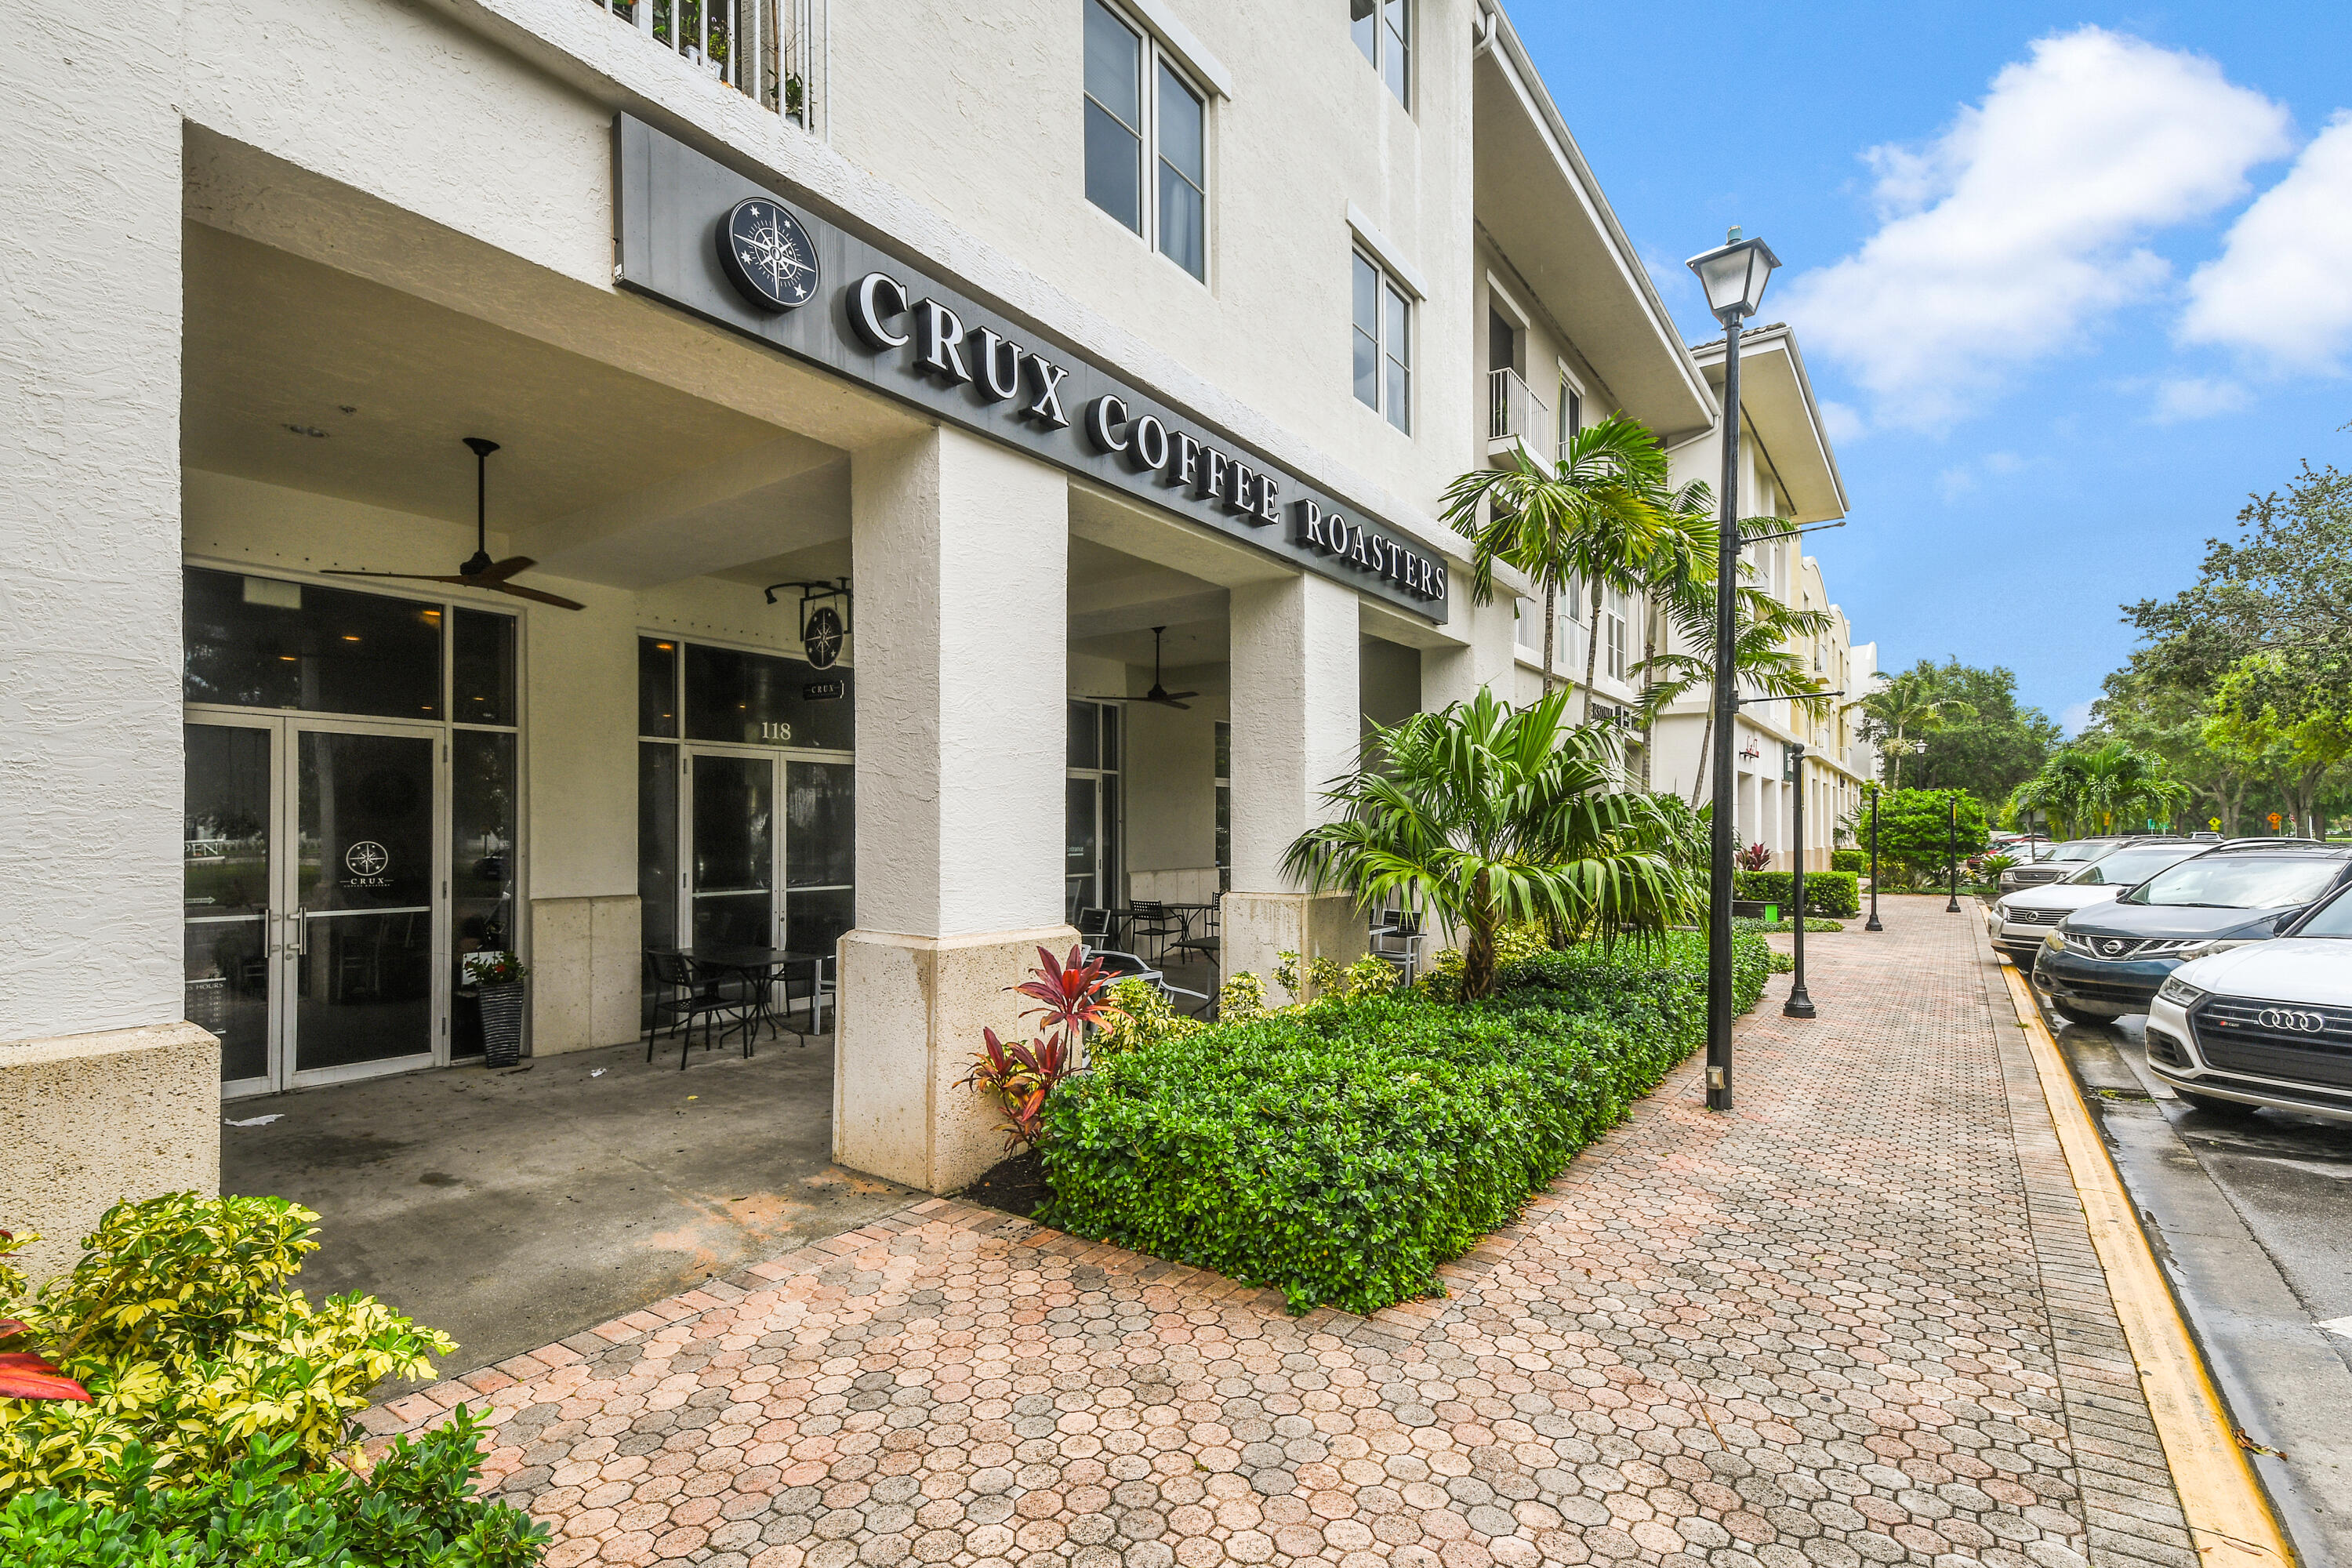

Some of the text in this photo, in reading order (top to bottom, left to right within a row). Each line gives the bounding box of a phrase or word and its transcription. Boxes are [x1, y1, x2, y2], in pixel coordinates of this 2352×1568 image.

[851, 271, 1445, 601] CRUX COFFEE ROASTERS
[811, 684, 834, 694] CRUX
[761, 721, 791, 741] 118
